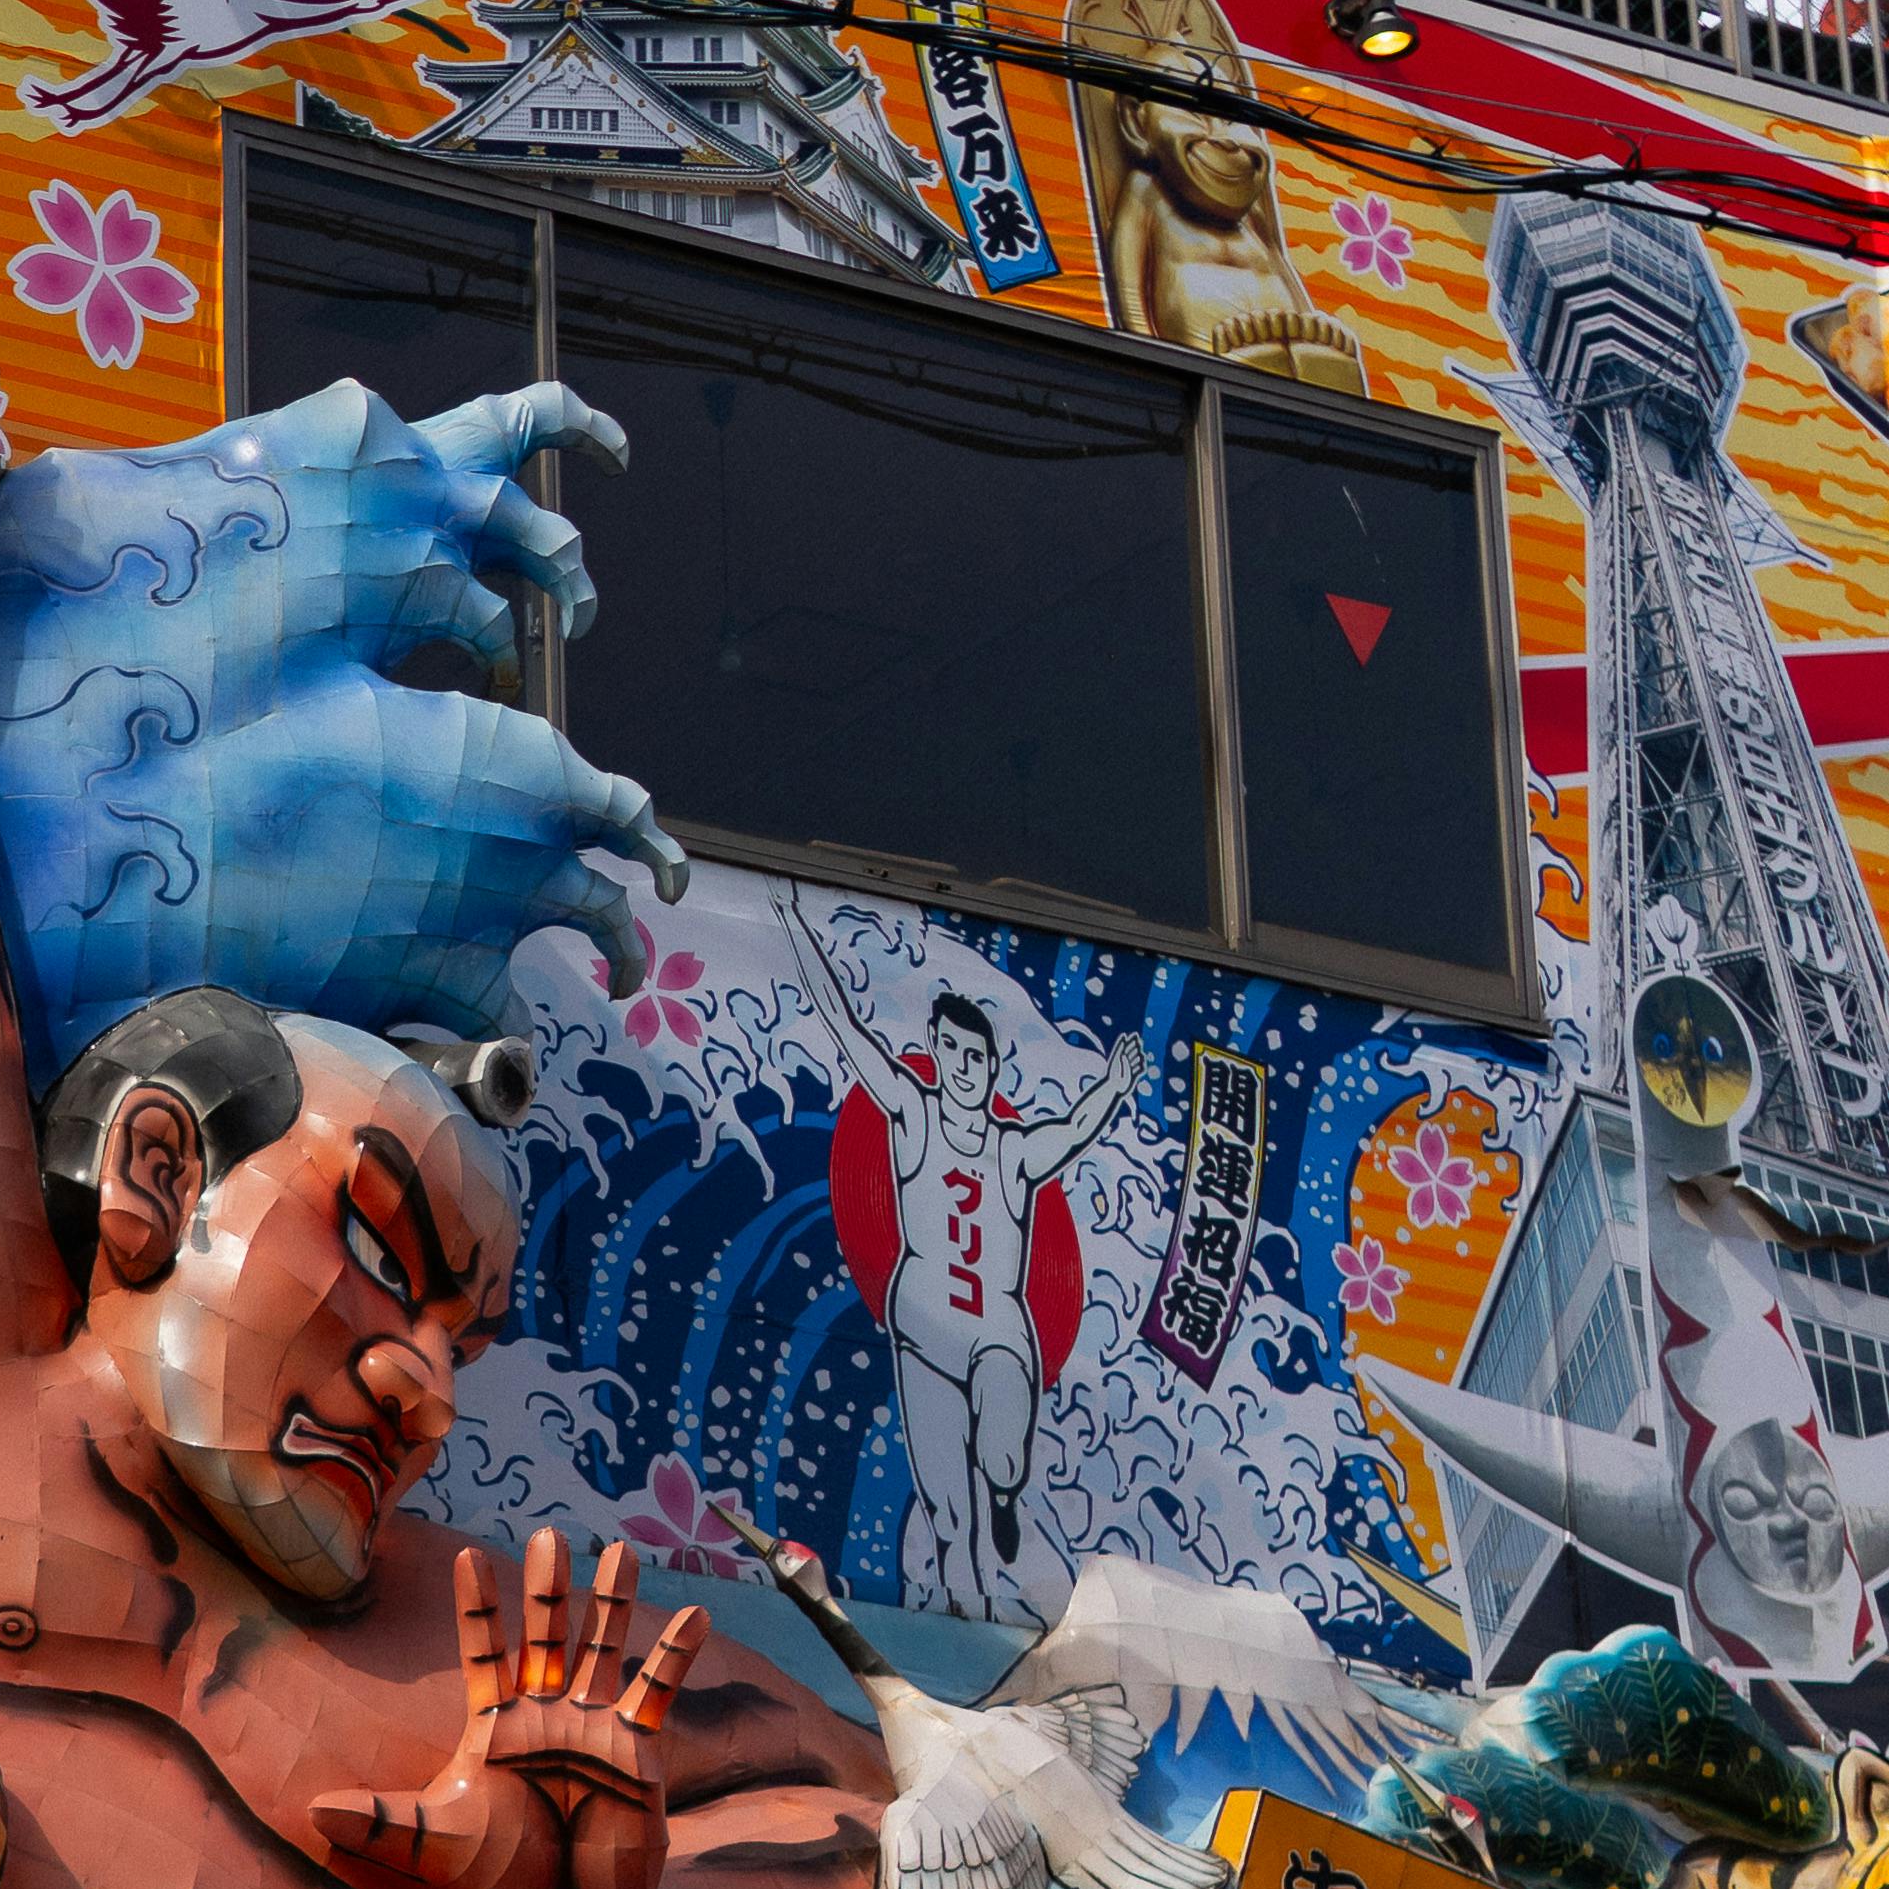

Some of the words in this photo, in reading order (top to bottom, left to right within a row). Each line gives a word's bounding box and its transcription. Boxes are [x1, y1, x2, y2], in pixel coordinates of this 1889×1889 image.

[941, 1167, 984, 1318] グリコ
[1164, 1056, 1258, 1354] 開運招福
